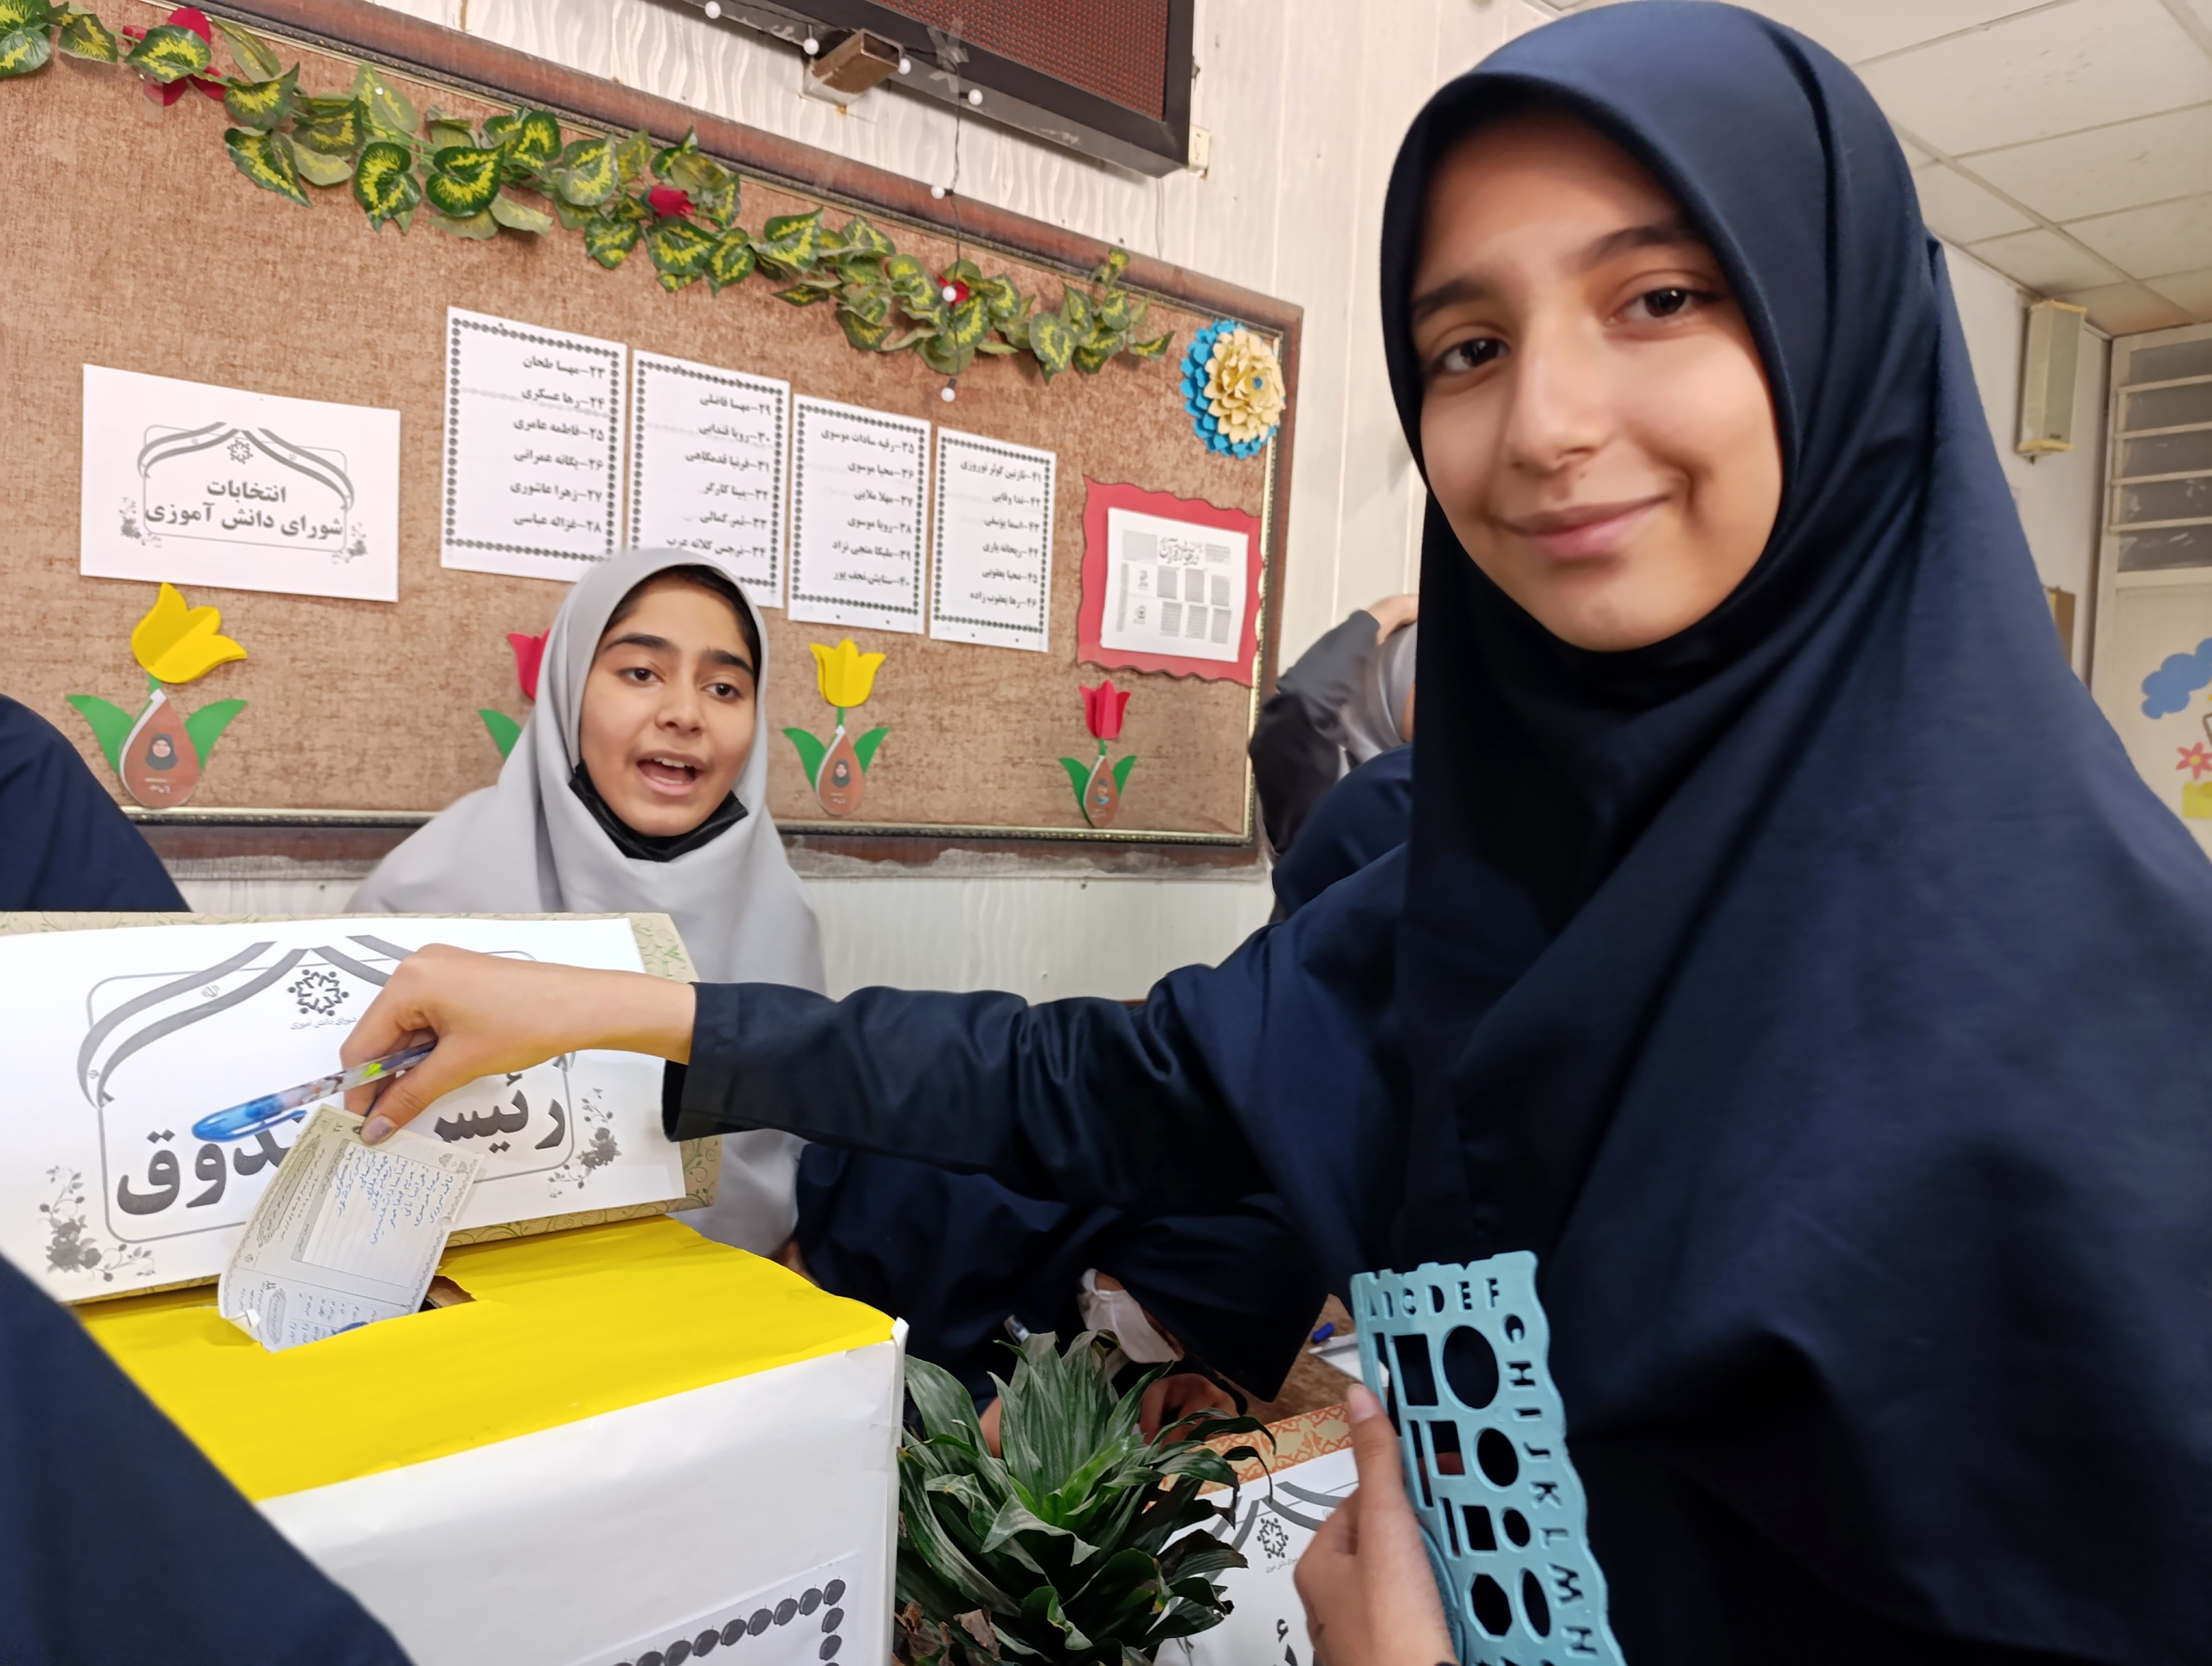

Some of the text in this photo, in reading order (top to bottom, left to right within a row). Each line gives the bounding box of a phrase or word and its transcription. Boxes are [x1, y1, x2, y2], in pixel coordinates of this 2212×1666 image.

[207, 479, 286, 503] انتخابات
[145, 502, 344, 540] شورای دانش آموزی
